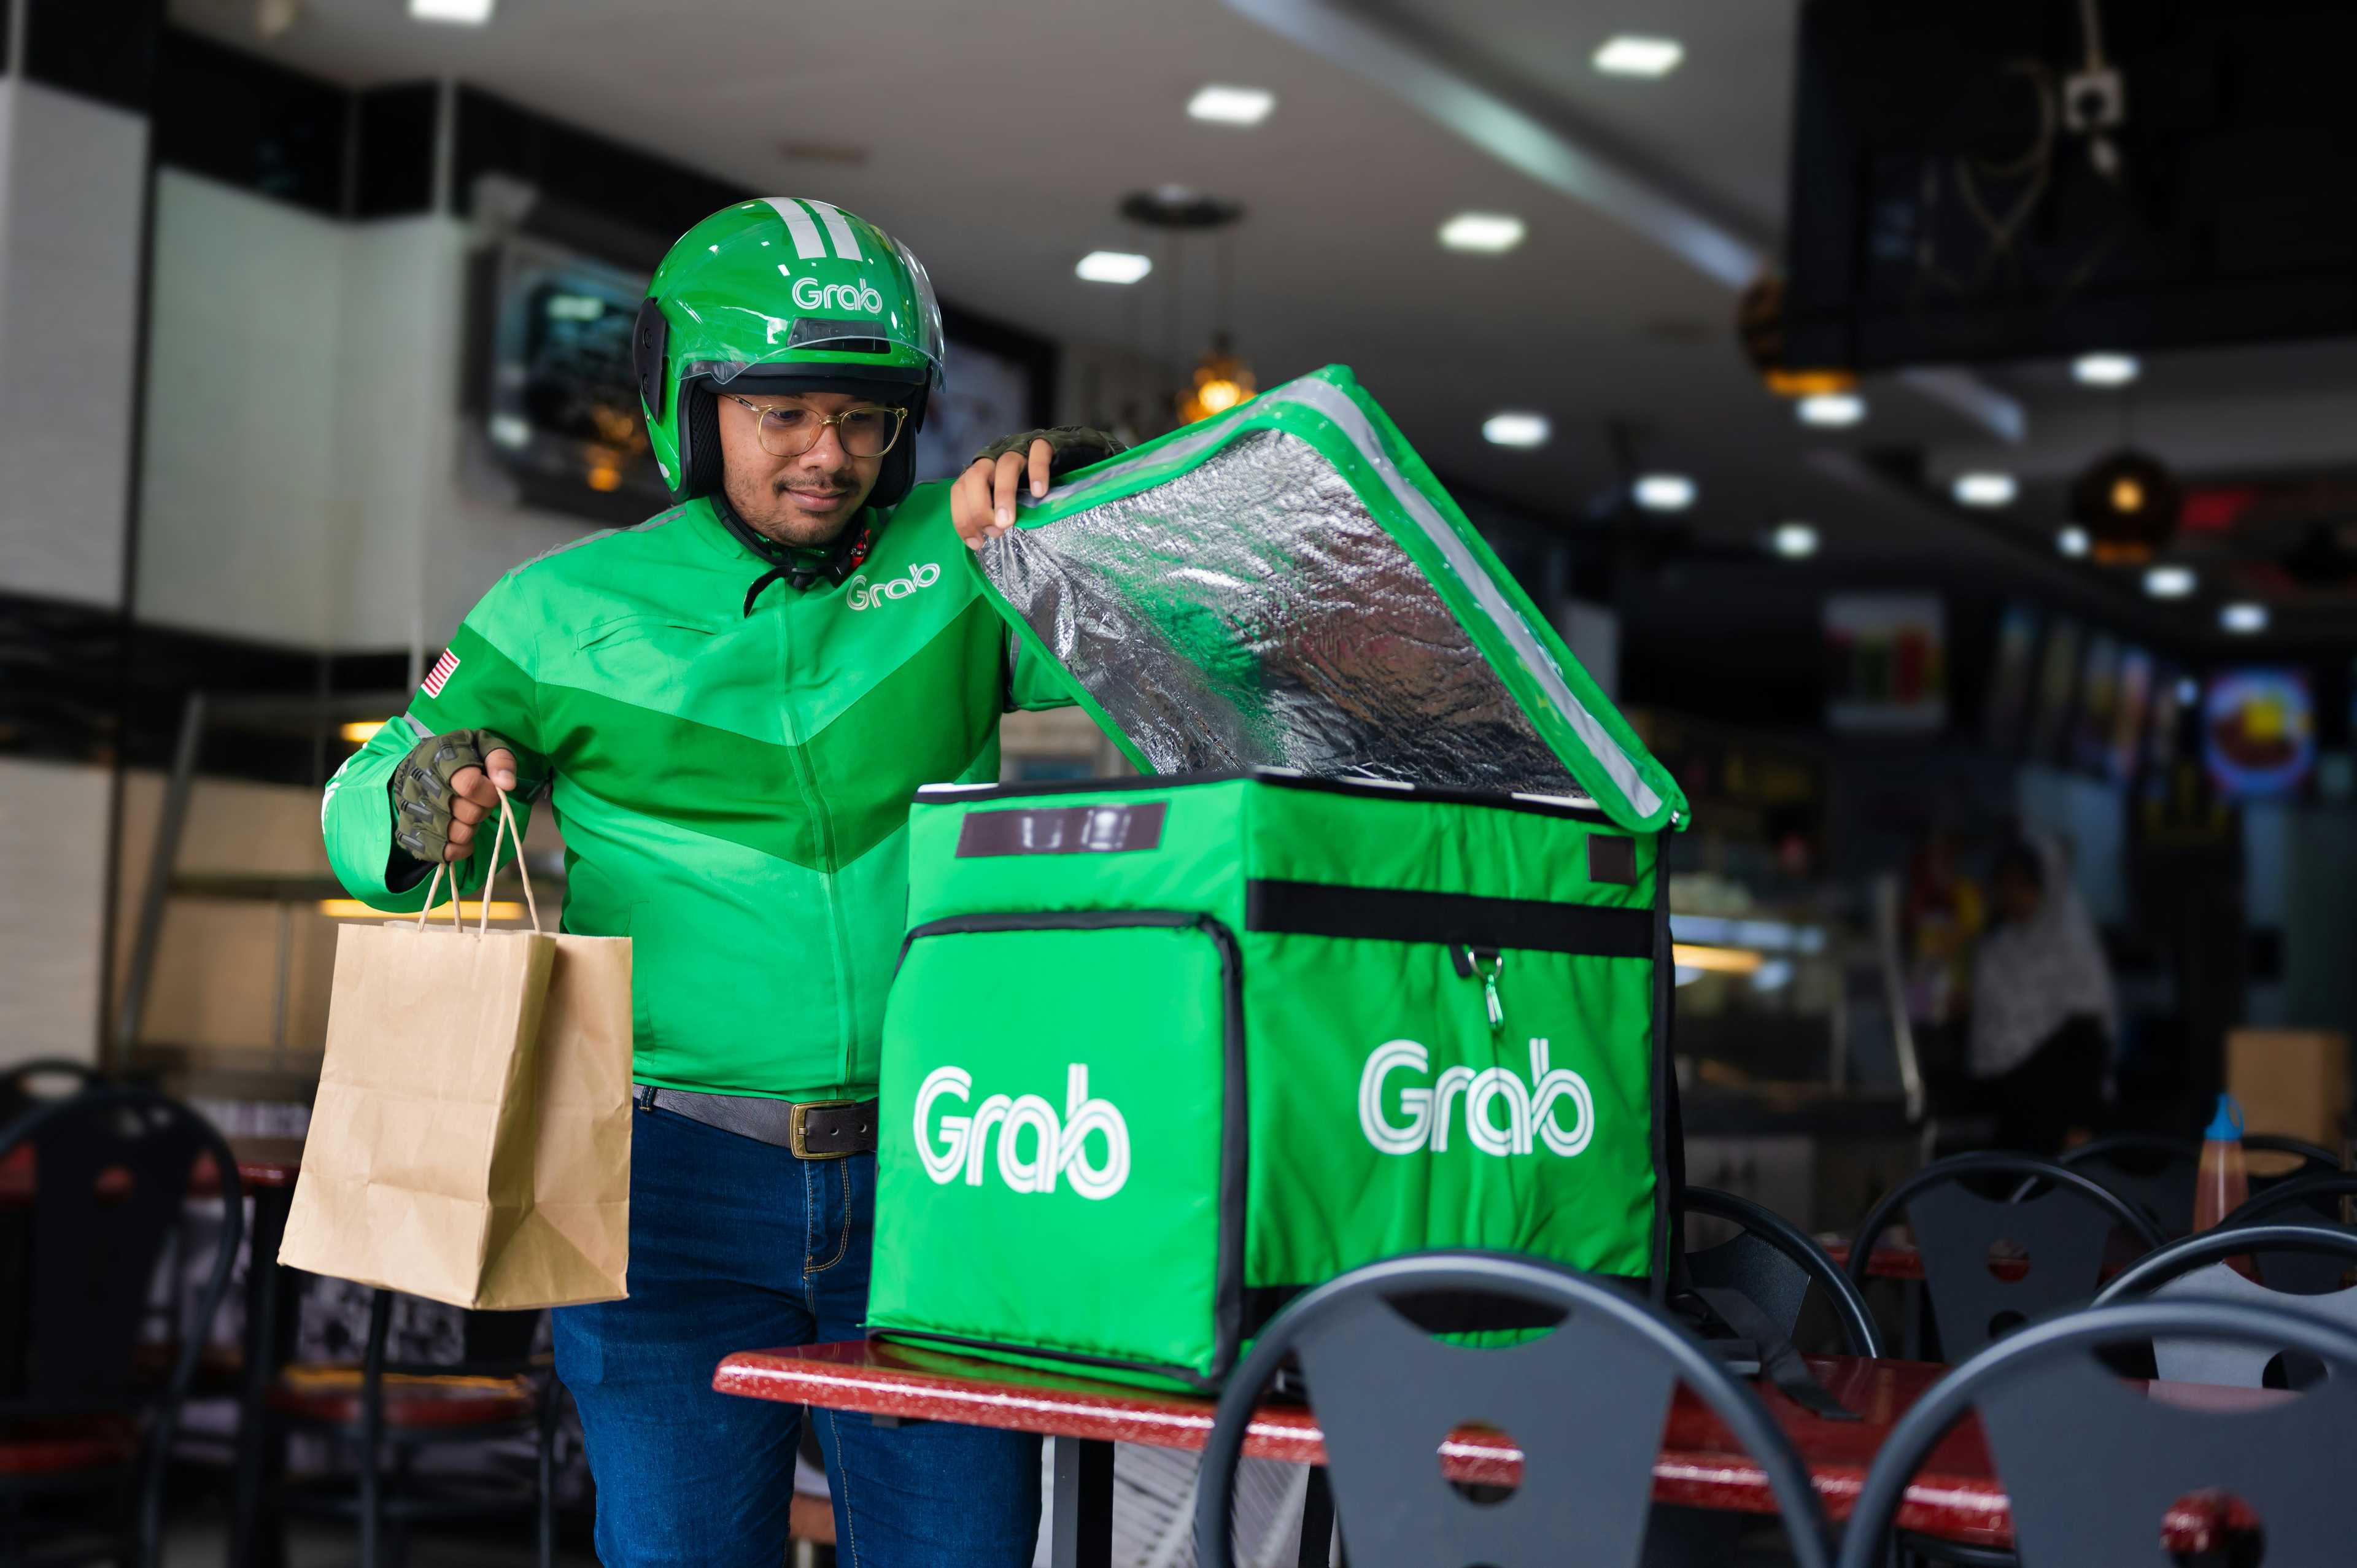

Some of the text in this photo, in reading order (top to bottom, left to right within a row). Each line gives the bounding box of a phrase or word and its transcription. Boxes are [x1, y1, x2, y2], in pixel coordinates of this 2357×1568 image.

[792, 277, 883, 314] Grab
[846, 563, 940, 611] Grab
[913, 1064, 1131, 1200] Grab
[1359, 1038, 1595, 1157] Grab
